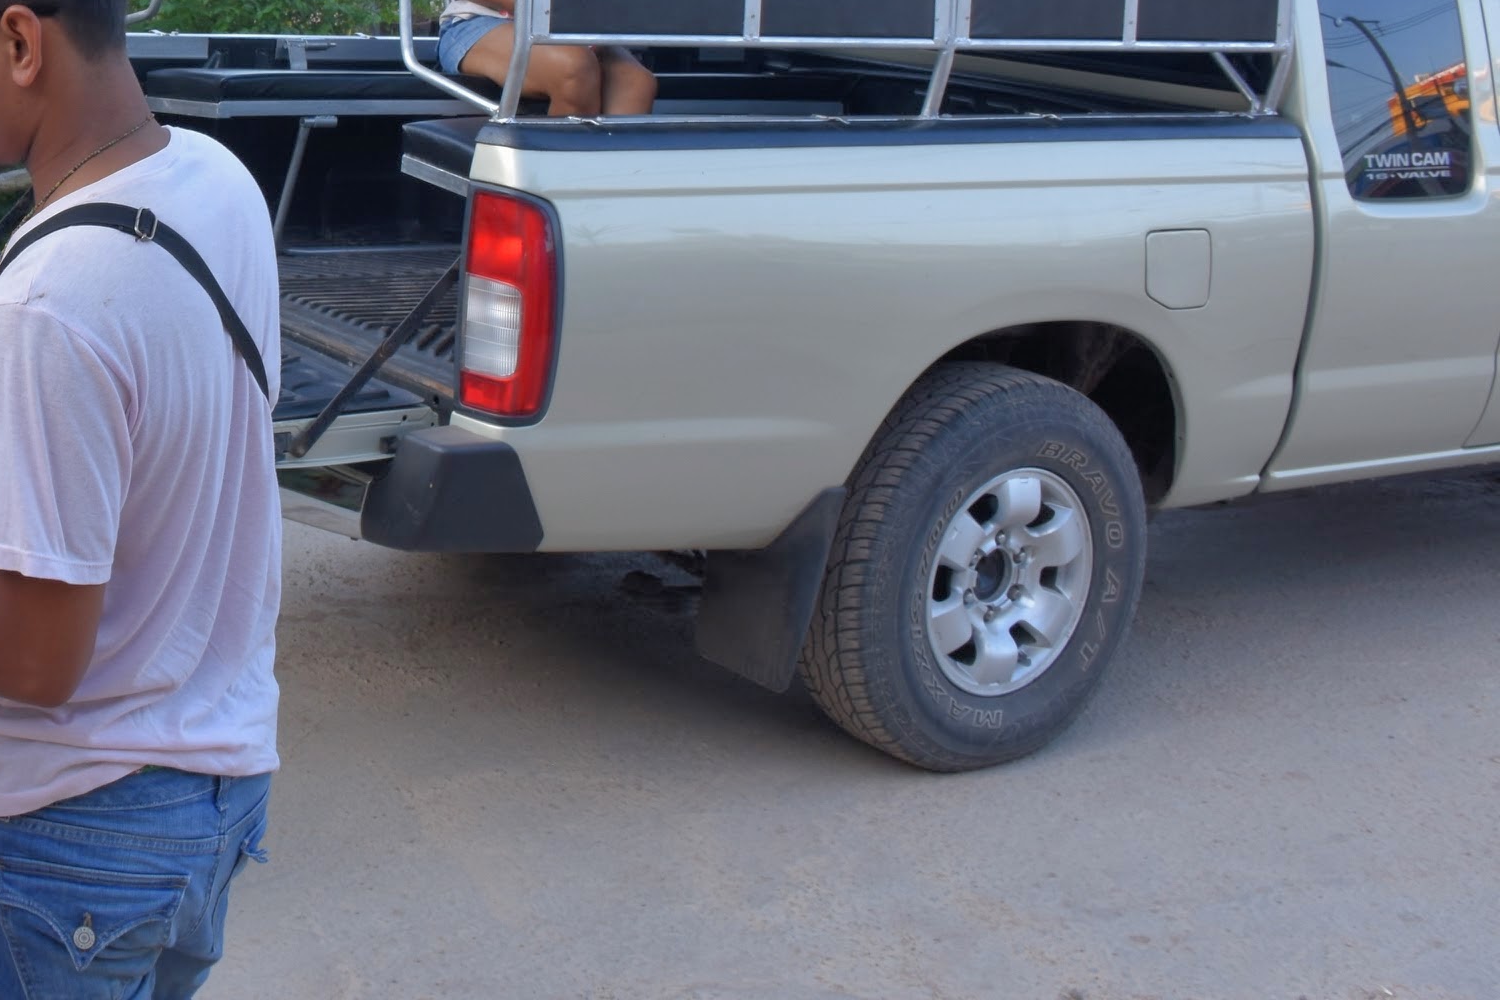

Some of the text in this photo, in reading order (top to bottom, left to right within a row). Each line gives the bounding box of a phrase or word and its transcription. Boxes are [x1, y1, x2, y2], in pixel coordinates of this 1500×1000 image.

[1364, 151, 1450, 168] TWIN CAM
[1036, 439, 1124, 549] BRAVO
[910, 589, 1004, 730] MAXXIS
